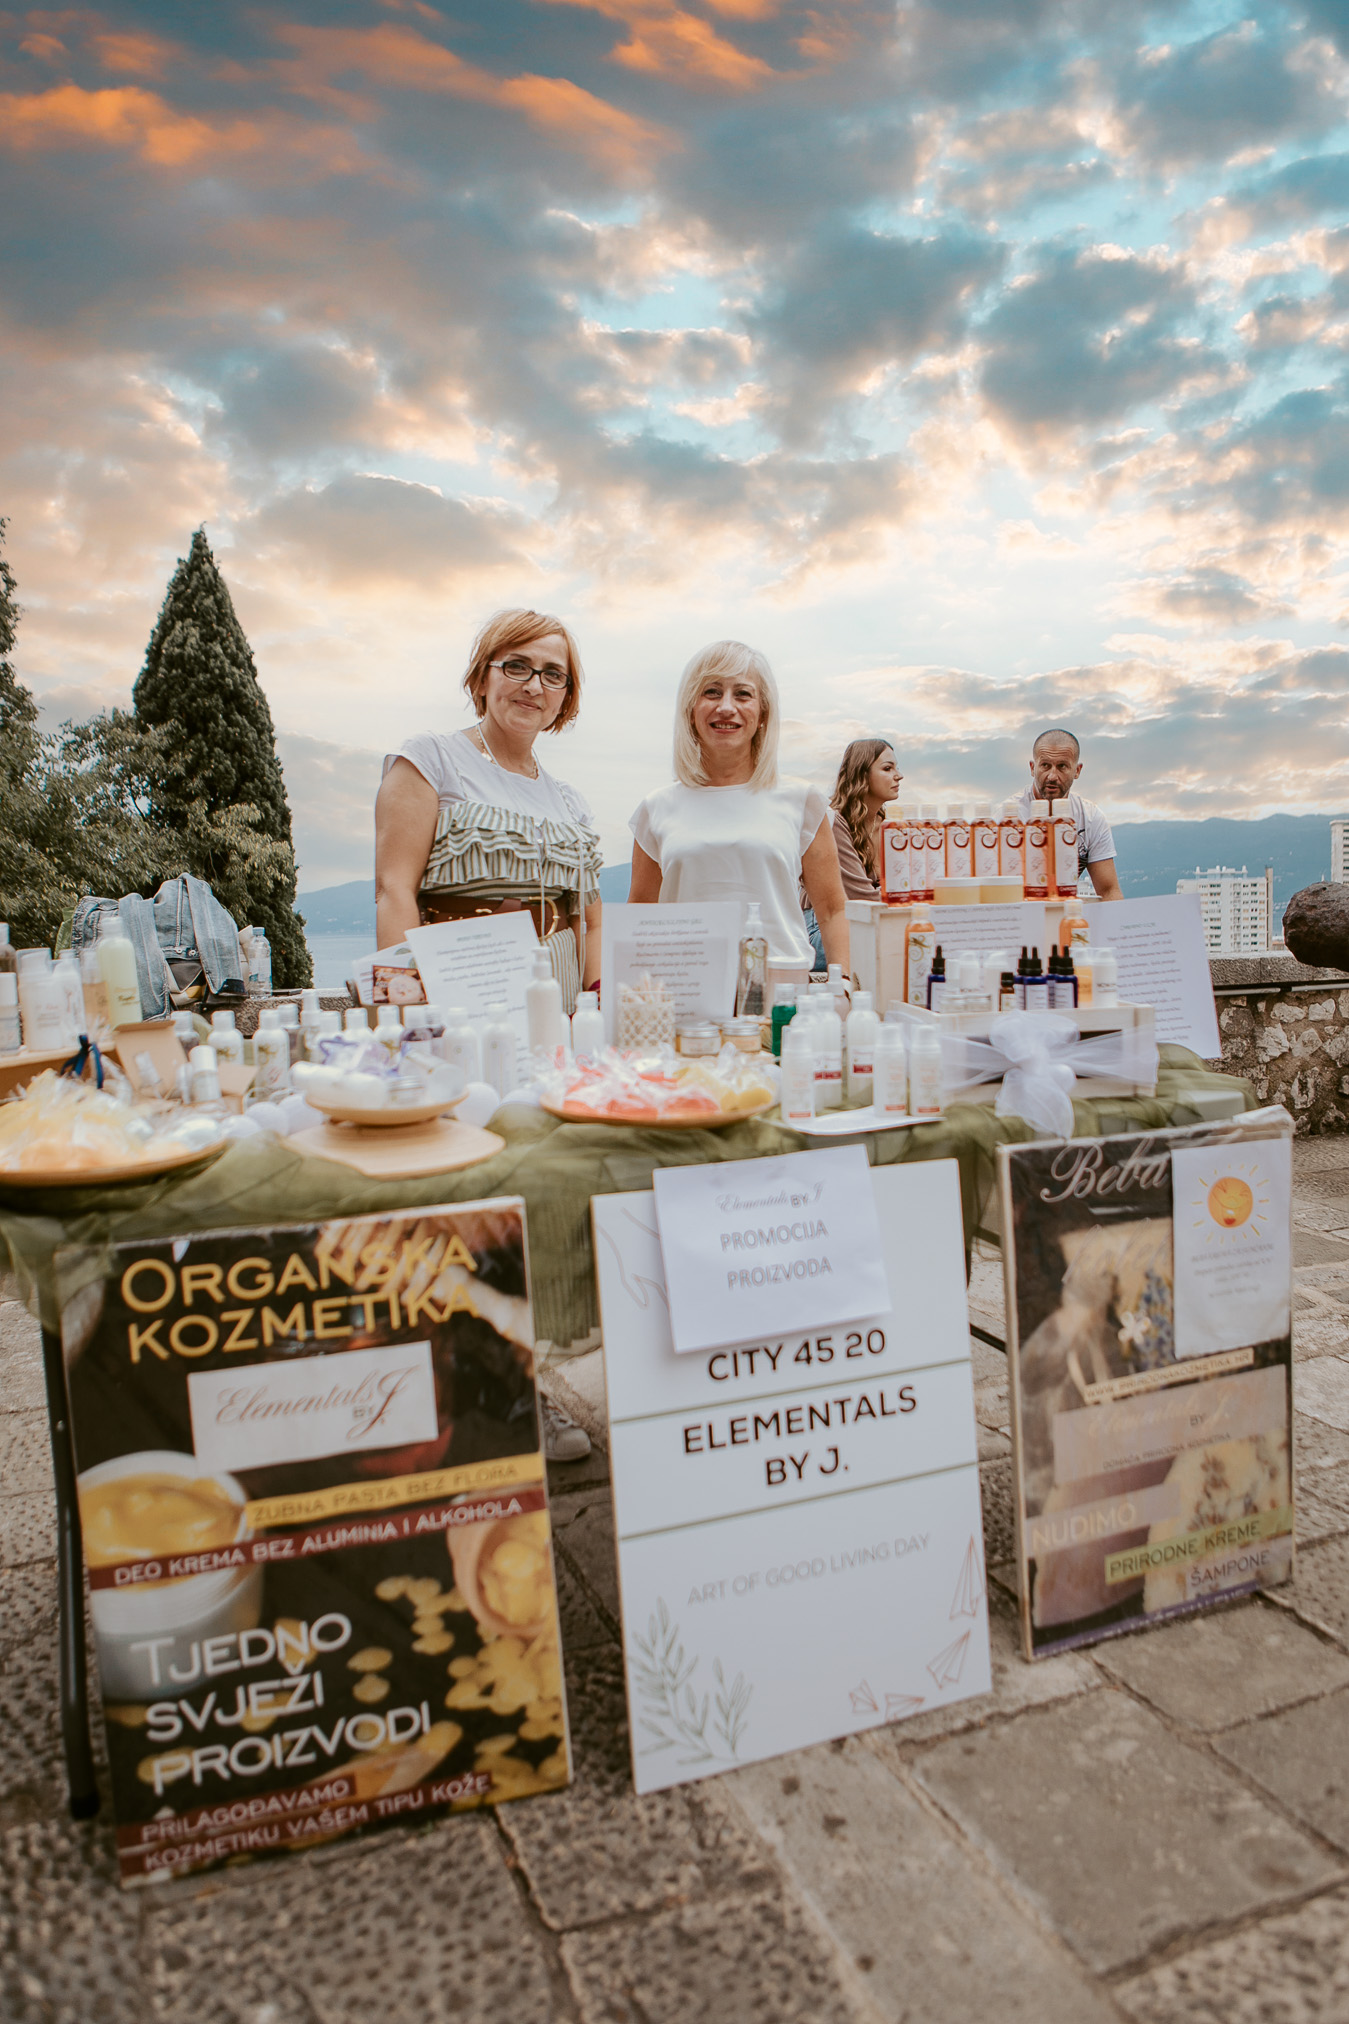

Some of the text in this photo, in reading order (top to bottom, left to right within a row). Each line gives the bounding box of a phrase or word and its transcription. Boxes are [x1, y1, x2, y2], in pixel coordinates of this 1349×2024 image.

[1040, 1137, 1171, 1203] Beba
[790, 1194, 808, 1208] BY
[720, 1219, 829, 1253] PROMOCIJA
[121, 1235, 478, 1313] ORGANSKA
[727, 1256, 833, 1291] PROIZVODA
[128, 1284, 480, 1364] KOZMETIKA
[708, 1328, 887, 1381] CITY 45 20
[216, 1369, 380, 1425] Elementals
[682, 1385, 918, 1454] ELEMENTALS
[254, 1463, 519, 1523] ZUBNA PASTA BEZ FLORA
[765, 1446, 849, 1486] BY J.
[114, 1497, 522, 1584] DEO KREMA BEZ ALUMINIA I ALKOHOLA
[1032, 1502, 1136, 1549] NUDIMO
[1109, 1520, 1261, 1579] PRIRODNE KREME
[687, 1532, 931, 1606] ART OF GOOD LIVING DAY
[1190, 1550, 1270, 1586] ŠAMPONE
[129, 1613, 352, 1686] TJEDNO
[151, 1701, 432, 1796] PROIZVODI
[144, 1771, 492, 1872] KOZMETIKU VAŠEM TIPU KOŽE
